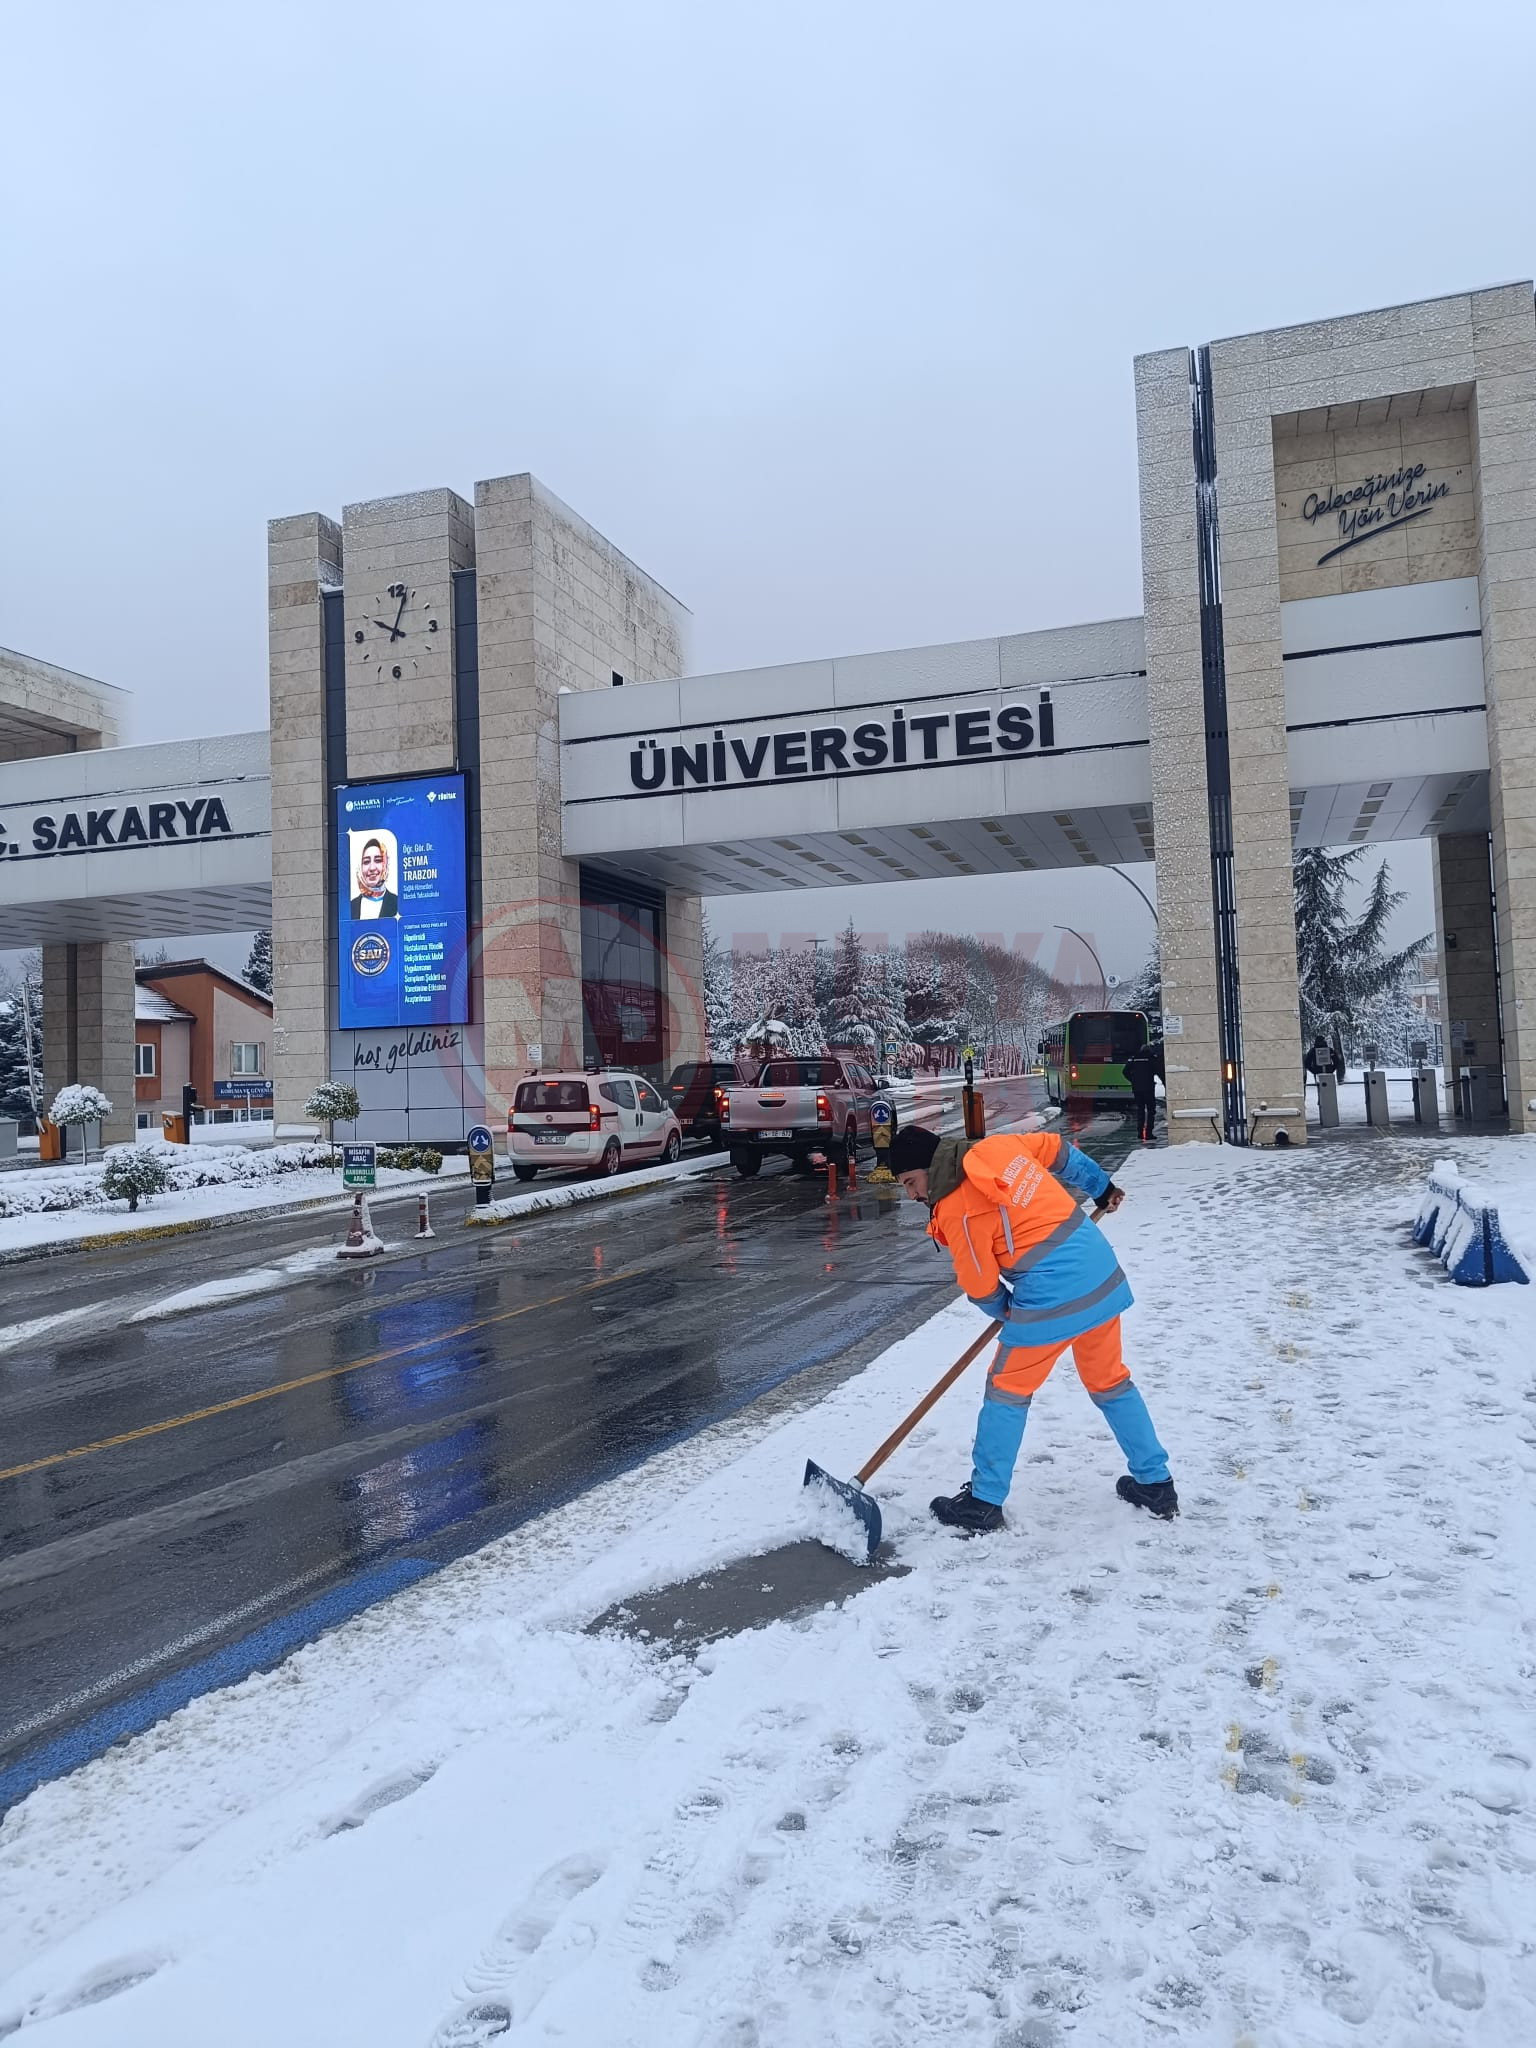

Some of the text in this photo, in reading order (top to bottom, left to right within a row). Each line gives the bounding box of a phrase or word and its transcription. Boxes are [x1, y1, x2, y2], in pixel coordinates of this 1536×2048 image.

[1303, 462, 1428, 525] Geleceğinize
[1338, 482, 1450, 538] Yön Verin
[387, 583, 405, 598] 12
[428, 619, 439, 633] 3
[354, 630, 365, 644] 9
[391, 665, 402, 679] 6
[629, 688, 1056, 790] ÜNİVERSİTESİ
[32, 795, 233, 851] SAKARYA
[402, 855, 429, 870] ŞEYMA
[403, 868, 438, 881] TRABZON
[354, 1029, 463, 1074] hoş geldiniz
